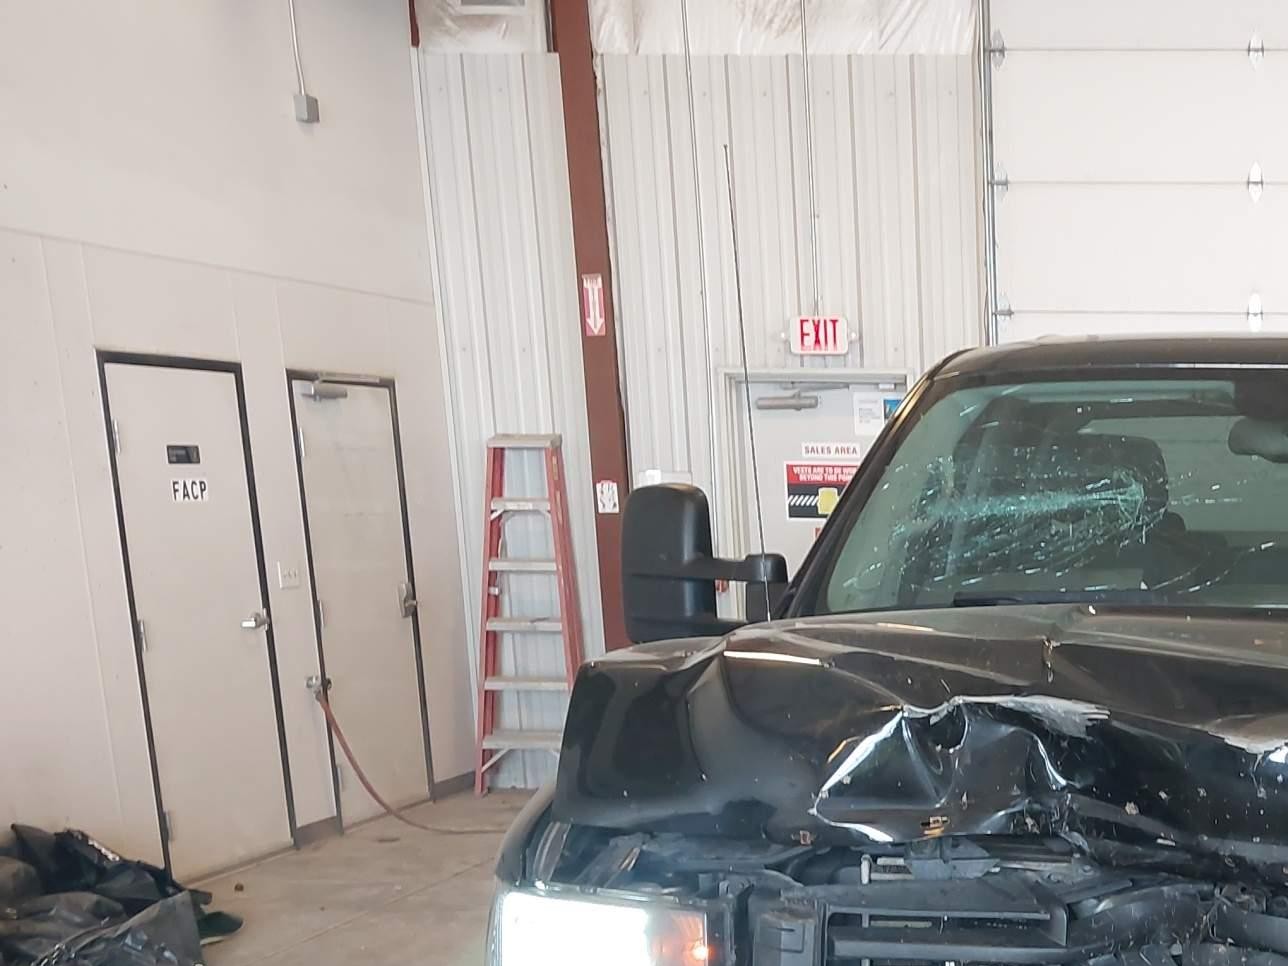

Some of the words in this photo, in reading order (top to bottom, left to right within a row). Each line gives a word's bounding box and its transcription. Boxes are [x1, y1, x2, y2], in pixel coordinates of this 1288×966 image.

[799, 318, 839, 351] EXIT
[804, 446, 832, 455] SALES
[834, 446, 858, 455] AREA
[825, 467, 834, 475] TO
[172, 480, 207, 501] FACP
